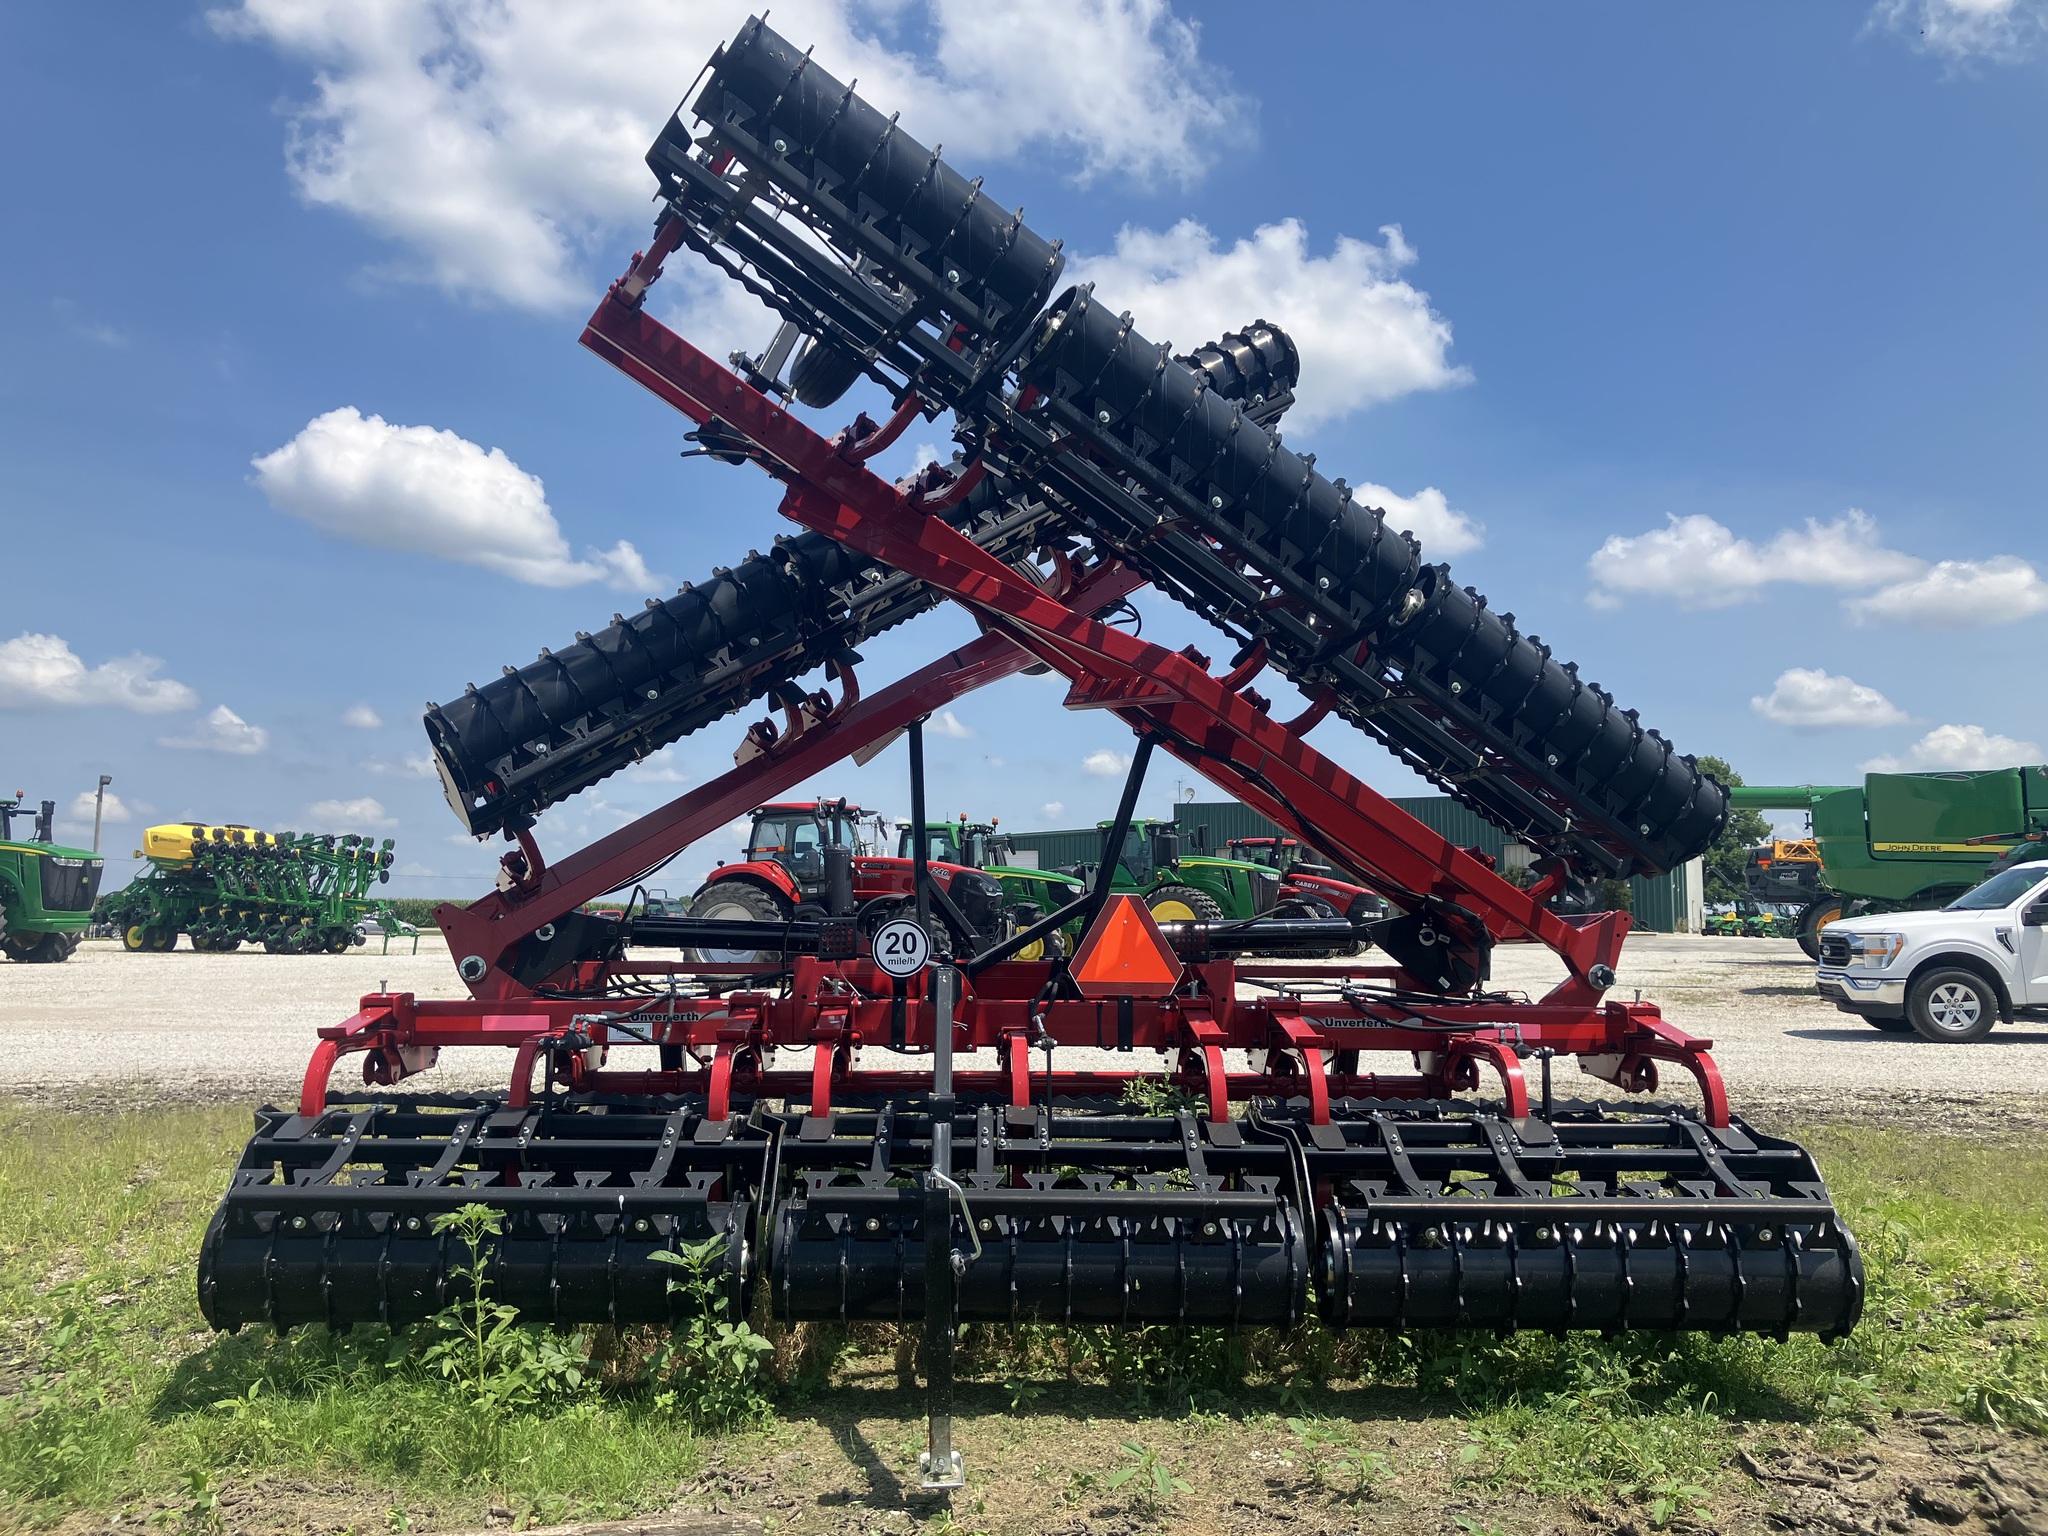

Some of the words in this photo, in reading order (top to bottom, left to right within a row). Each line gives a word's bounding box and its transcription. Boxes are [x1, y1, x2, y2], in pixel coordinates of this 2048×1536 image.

[885, 932, 917, 955] 20
[888, 957, 916, 966] mile/h
[631, 1012, 699, 1021] Unvererth
